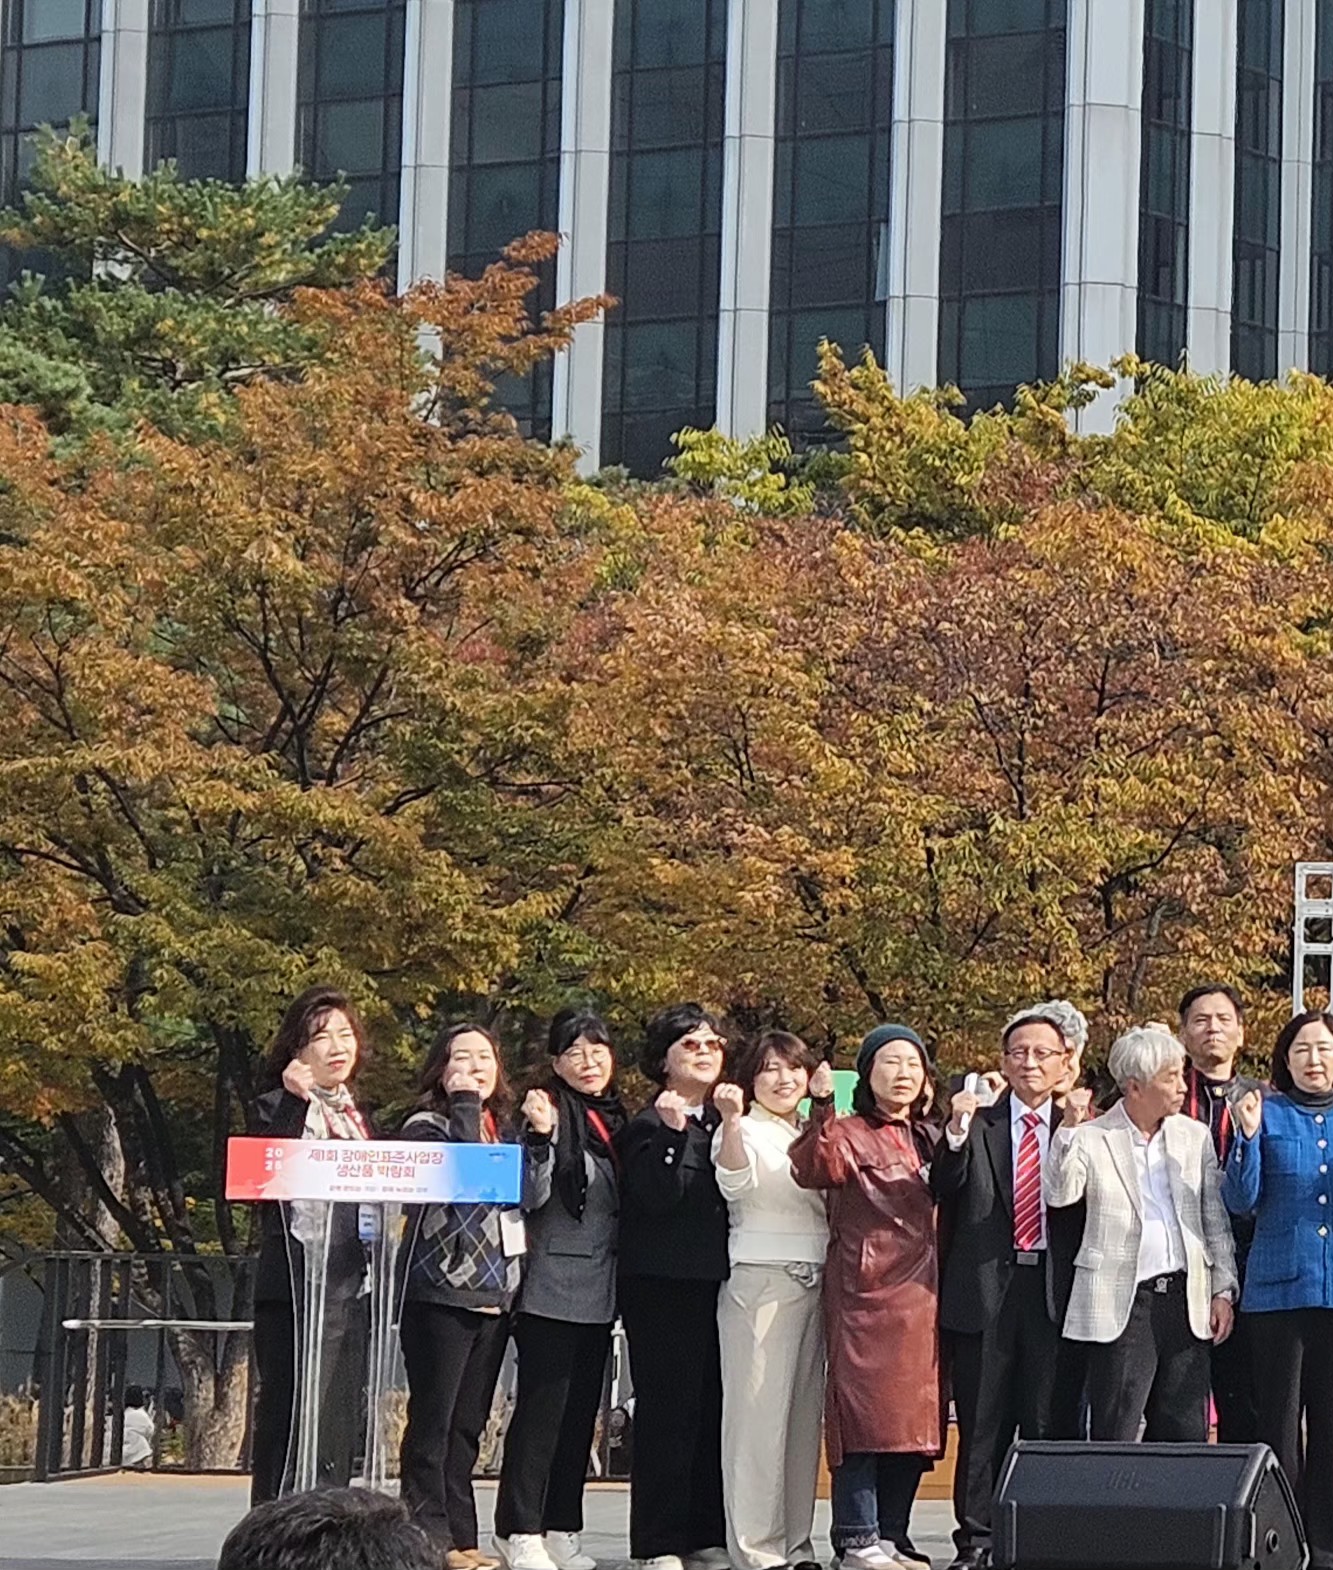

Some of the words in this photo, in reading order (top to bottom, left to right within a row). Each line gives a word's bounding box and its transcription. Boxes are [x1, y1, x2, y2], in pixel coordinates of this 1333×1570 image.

[264, 1147, 284, 1158] 20
[307, 1149, 338, 1162] 제1회
[337, 1163, 374, 1178] 생산품
